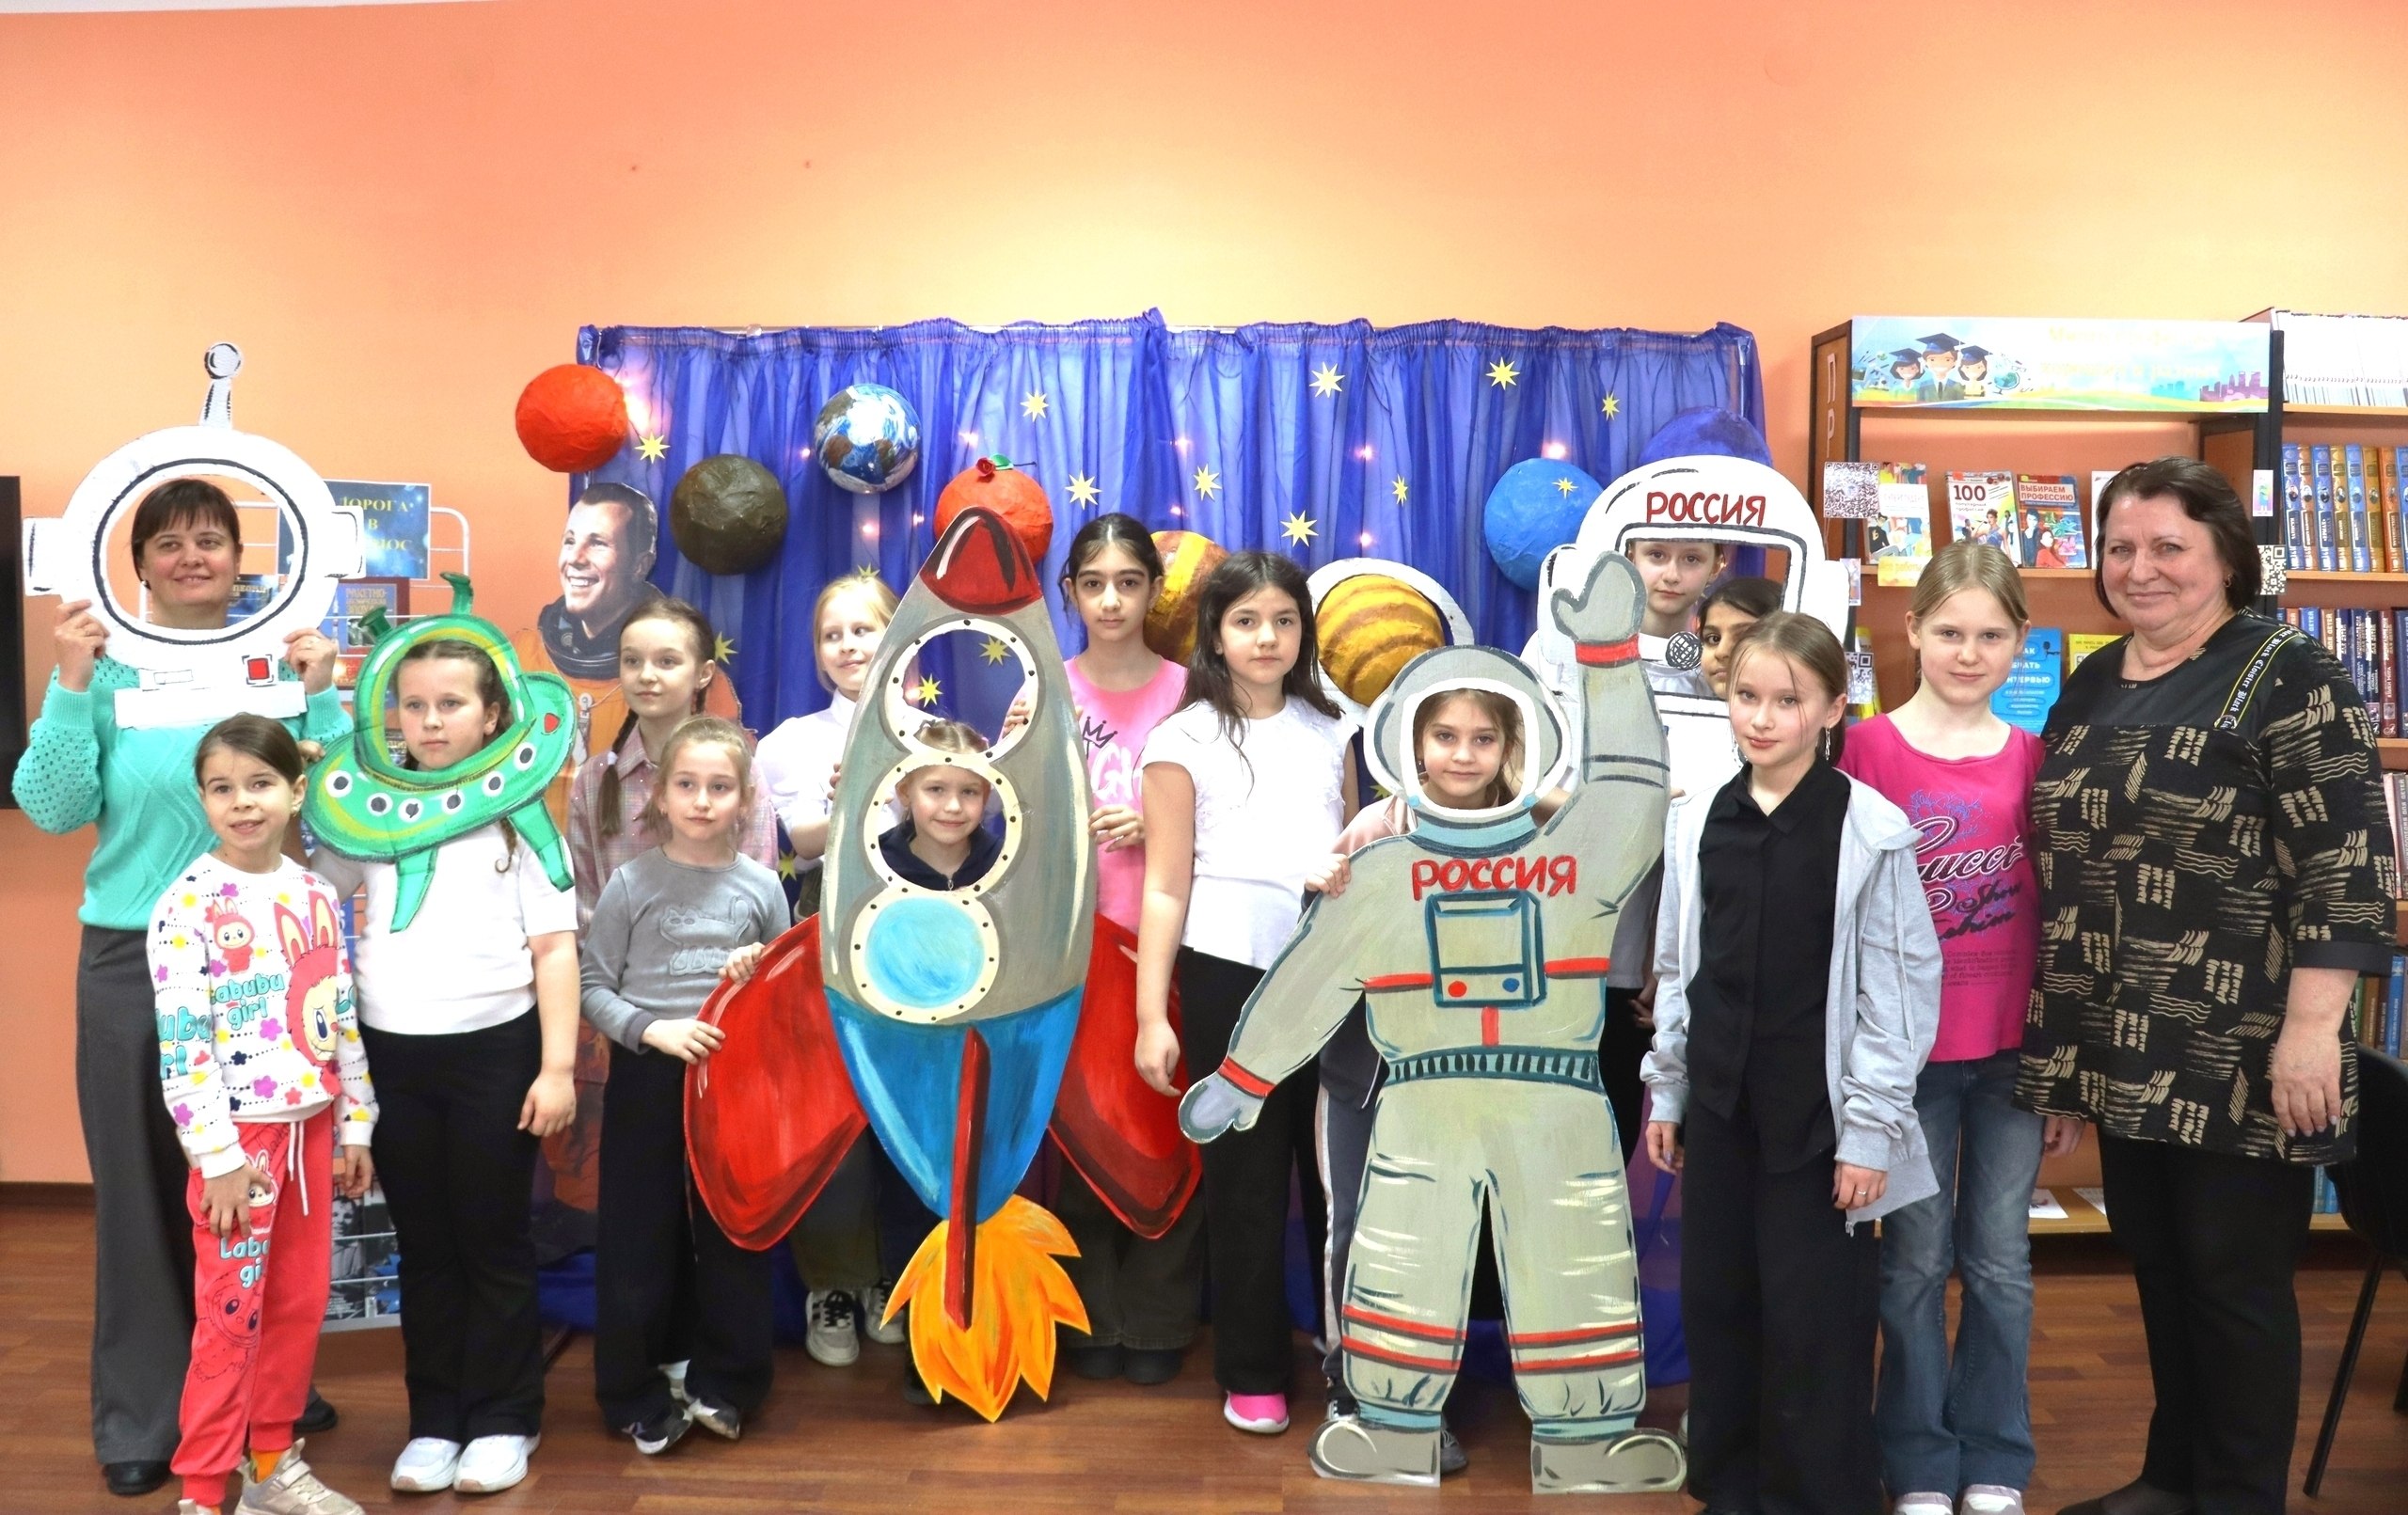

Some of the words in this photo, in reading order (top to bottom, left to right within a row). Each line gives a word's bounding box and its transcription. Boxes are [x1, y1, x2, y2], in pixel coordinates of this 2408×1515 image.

[1953, 484, 1987, 501] 100
[2020, 484, 2067, 494] ВЫБИРАЕМ
[2020, 492, 2074, 501] ПРОФЕССИЮ
[1646, 491, 1766, 528] РОССИЯ
[368, 518, 379, 530] В
[1412, 854, 1576, 901] РОССИЯ
[210, 973, 285, 1004] abubu
[227, 997, 268, 1031] girl
